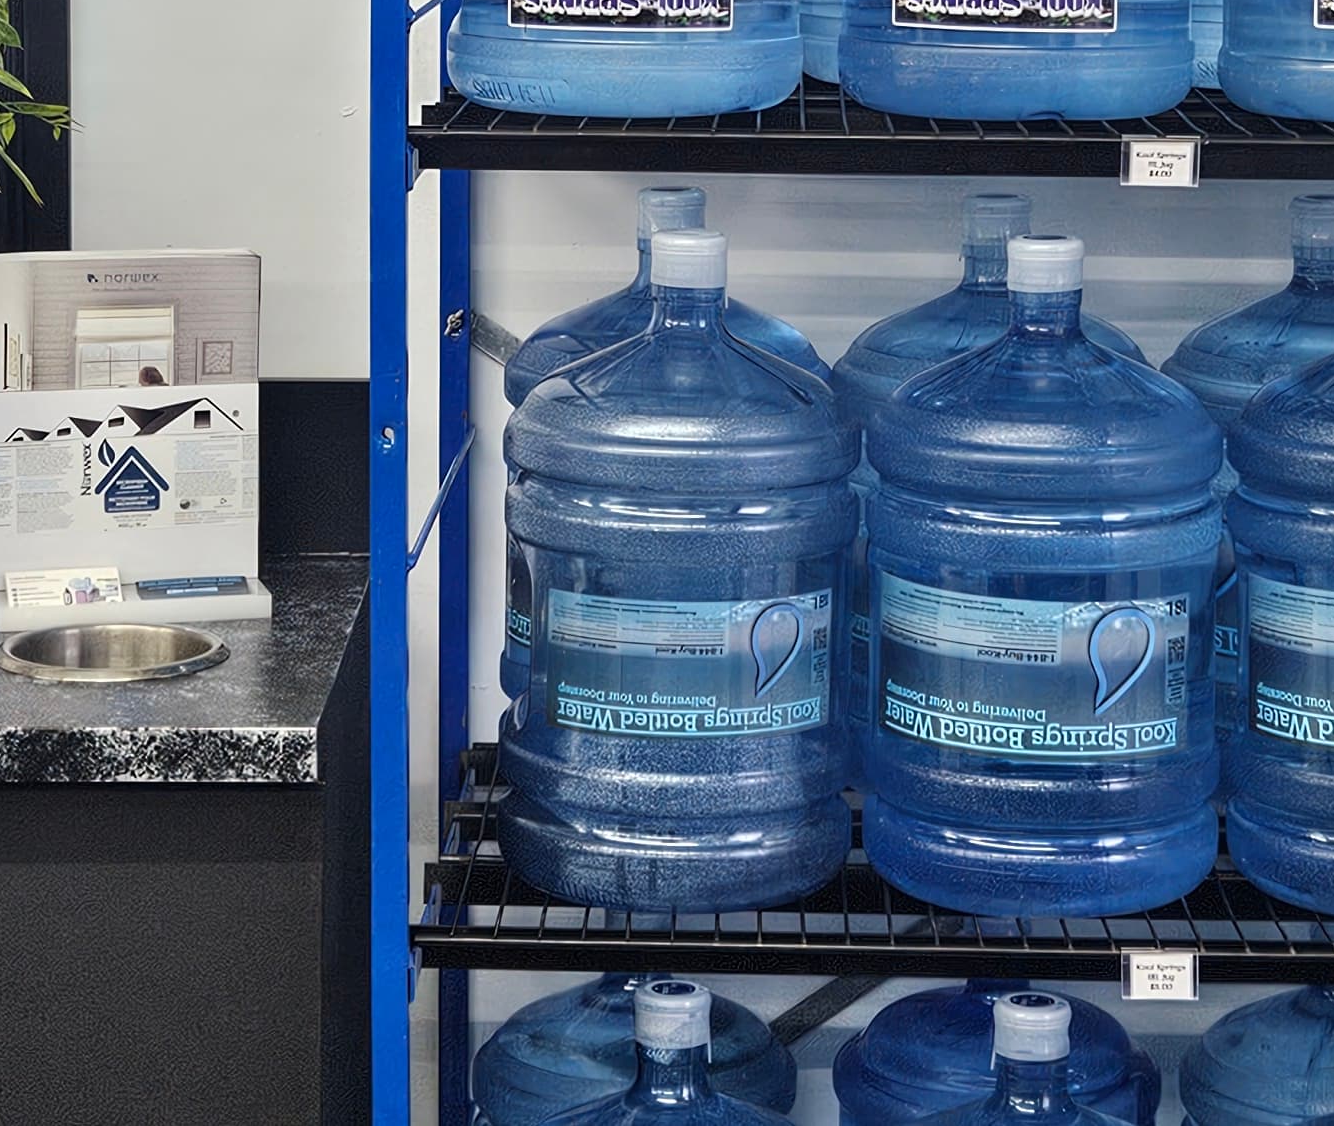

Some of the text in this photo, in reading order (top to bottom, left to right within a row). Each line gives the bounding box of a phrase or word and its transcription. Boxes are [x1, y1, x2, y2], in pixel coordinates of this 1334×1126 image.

[557, 702, 614, 730] Water
[620, 709, 698, 732] Bottled
[705, 705, 782, 727] Springs
[885, 702, 1178, 751] Kool Springs Bottled Water
[1256, 704, 1312, 742] Water
